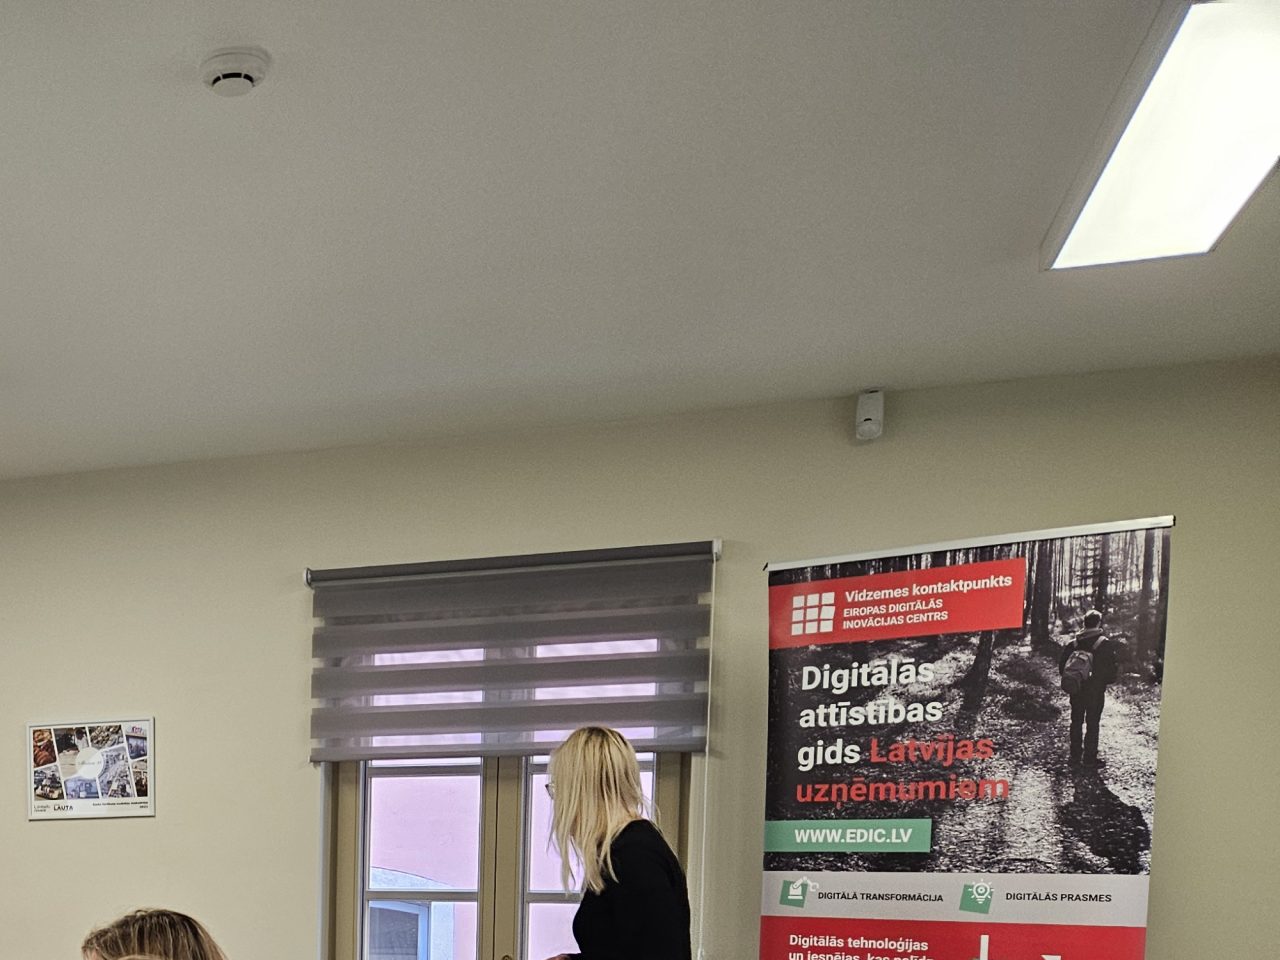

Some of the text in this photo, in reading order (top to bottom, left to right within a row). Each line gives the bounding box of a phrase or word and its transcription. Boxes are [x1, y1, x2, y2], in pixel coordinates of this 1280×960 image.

[845, 574, 1012, 603] Vidzemes kontaktpunkts
[843, 598, 943, 618] EIROPAS DIGITĀLĀS
[842, 609, 948, 629] INOVĀCIJAS CENTRS
[801, 656, 936, 694] Digitālās
[799, 697, 943, 728] attīstības
[797, 733, 994, 772] gids Latvijas
[796, 776, 1010, 810] uzņēmumiem
[794, 827, 913, 844] WWW.EDIC.LV
[818, 890, 944, 903] DIGITĀLĀ TRANSFORMĀCIJA
[1005, 890, 1112, 903] DIGITĀLĀS PRASMES
[789, 934, 929, 952] Digitālās tehnoloģijas
